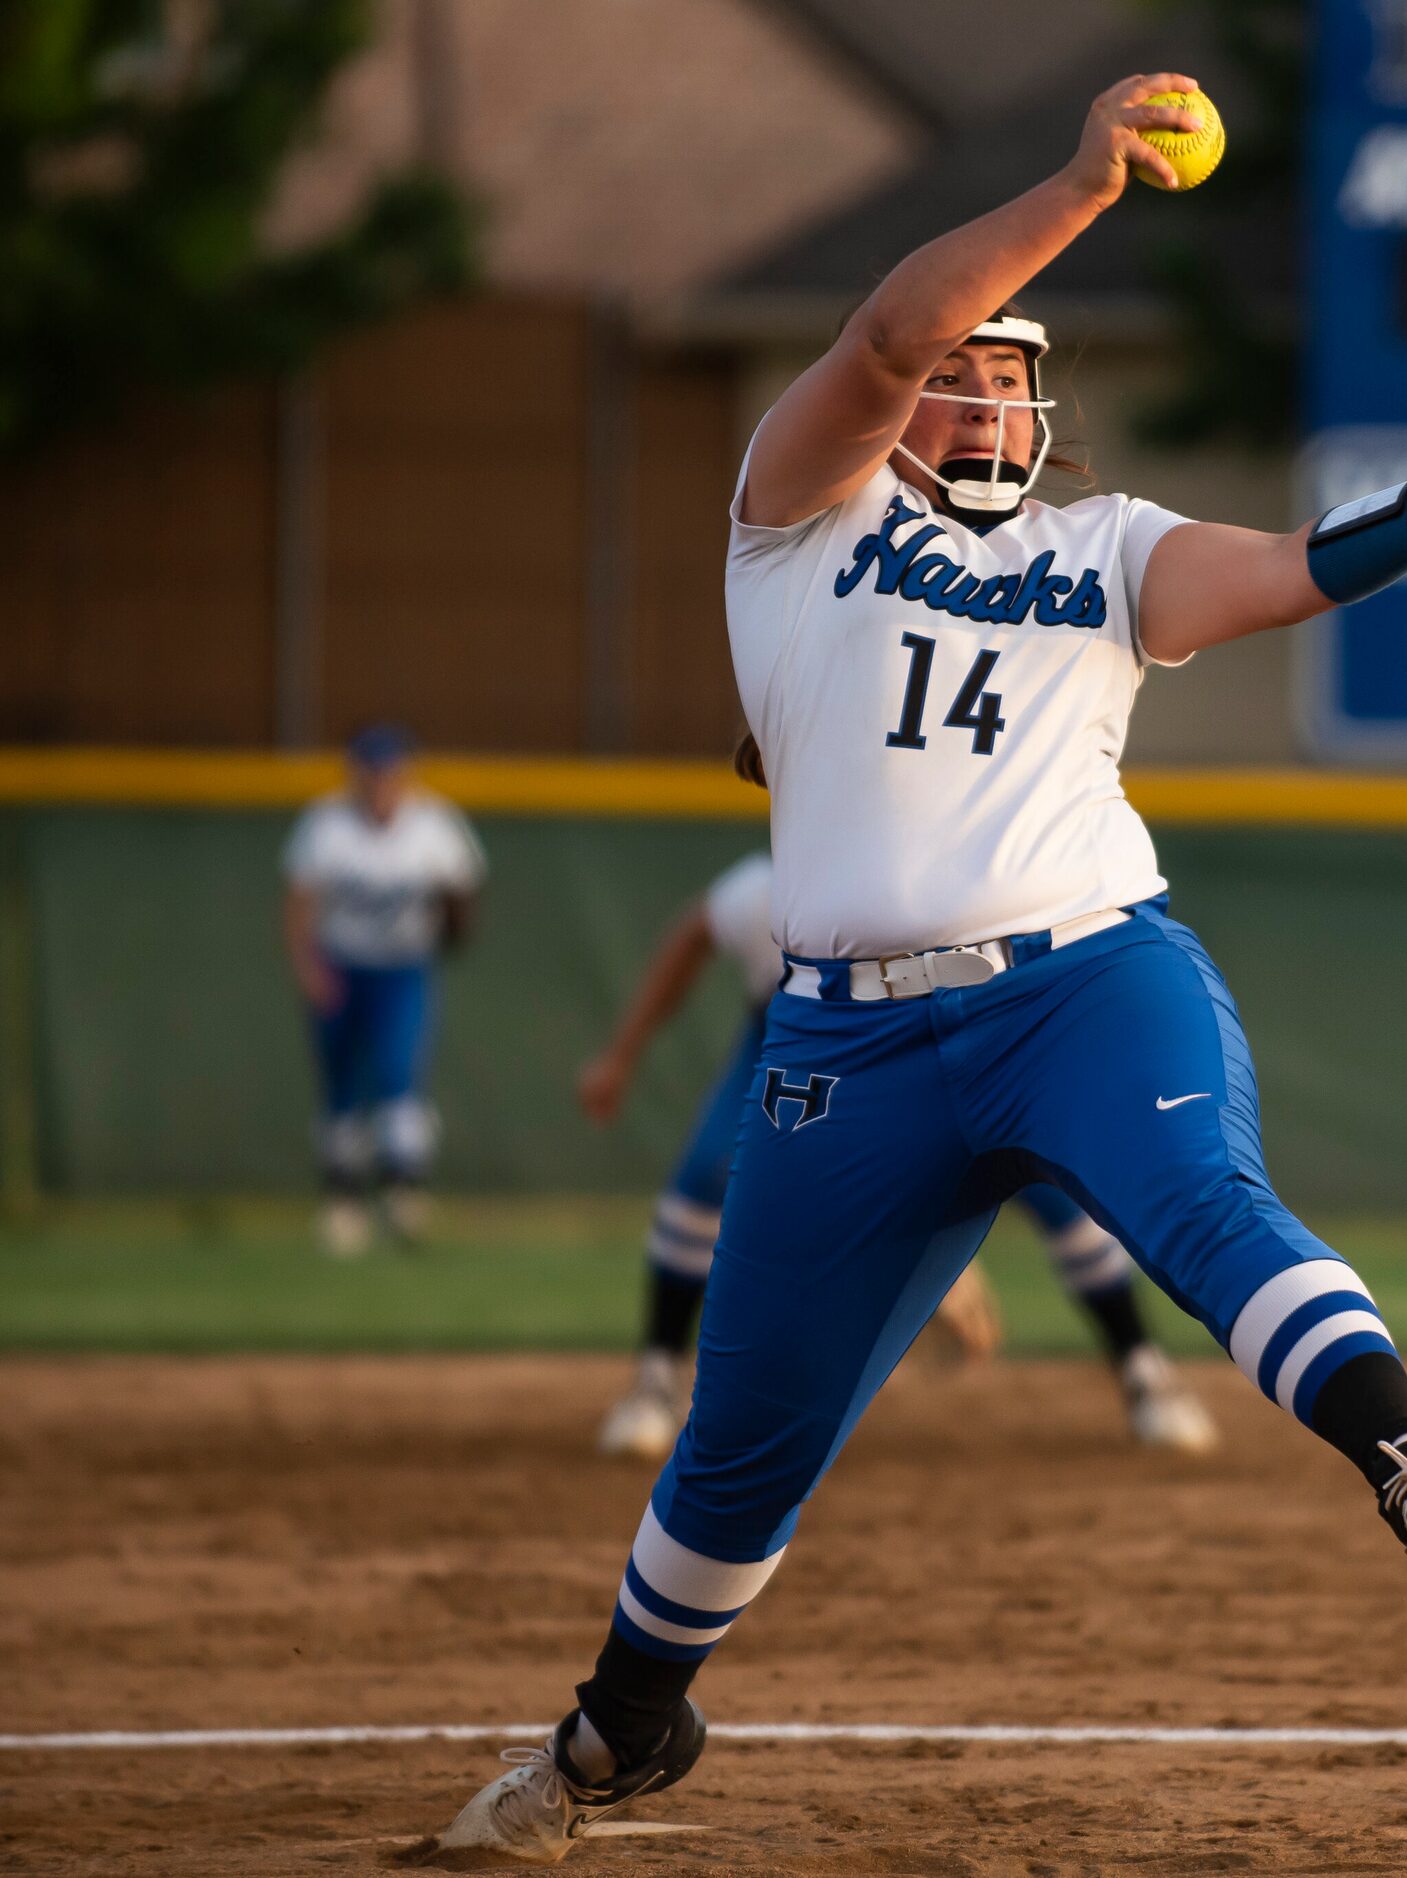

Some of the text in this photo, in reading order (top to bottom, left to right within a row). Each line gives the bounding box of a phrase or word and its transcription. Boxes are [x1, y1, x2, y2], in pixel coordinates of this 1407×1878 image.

[833, 494, 1107, 629] Hawks
[884, 630, 1006, 756] 14
[760, 1067, 841, 1133] H
